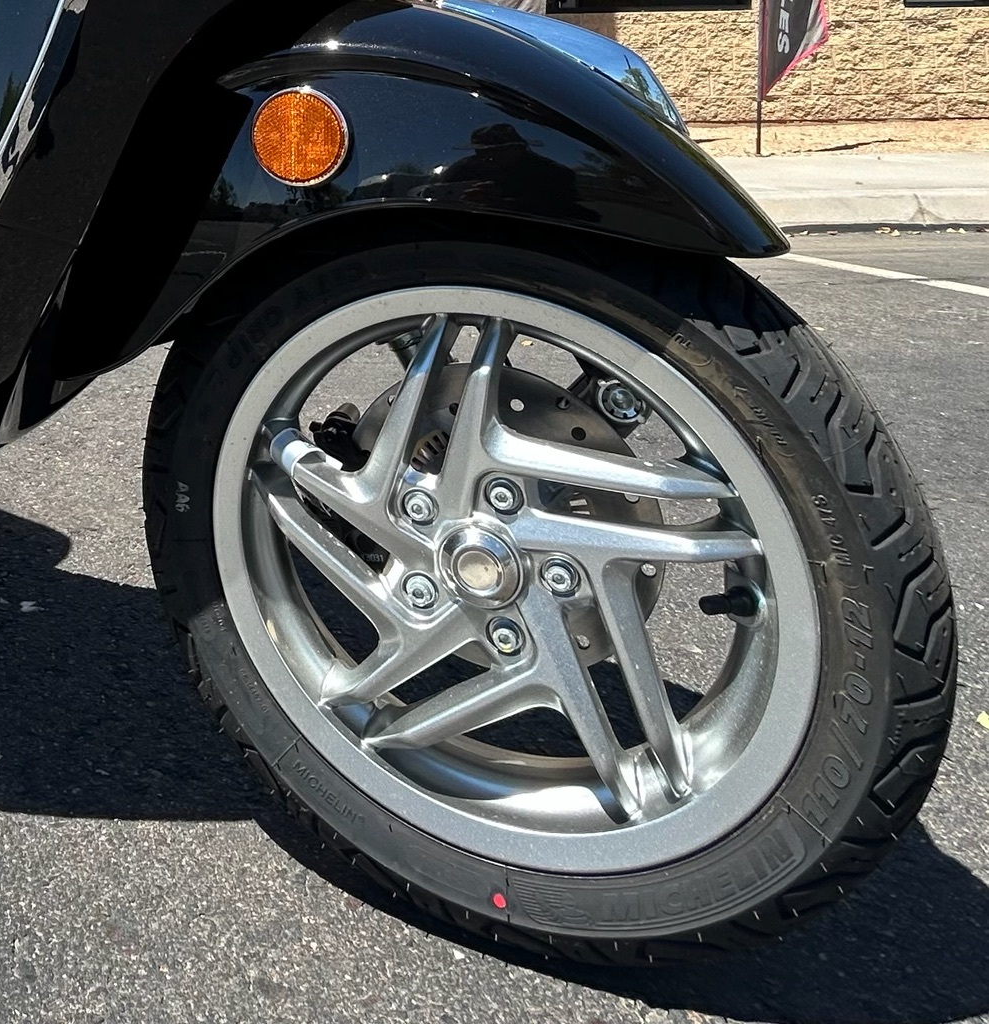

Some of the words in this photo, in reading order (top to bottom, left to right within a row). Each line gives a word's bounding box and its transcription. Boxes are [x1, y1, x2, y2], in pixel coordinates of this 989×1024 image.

[801, 596, 874, 826] 110/70-12
[291, 759, 358, 824] MICHELIN
[602, 828, 795, 922] MICHELIN
